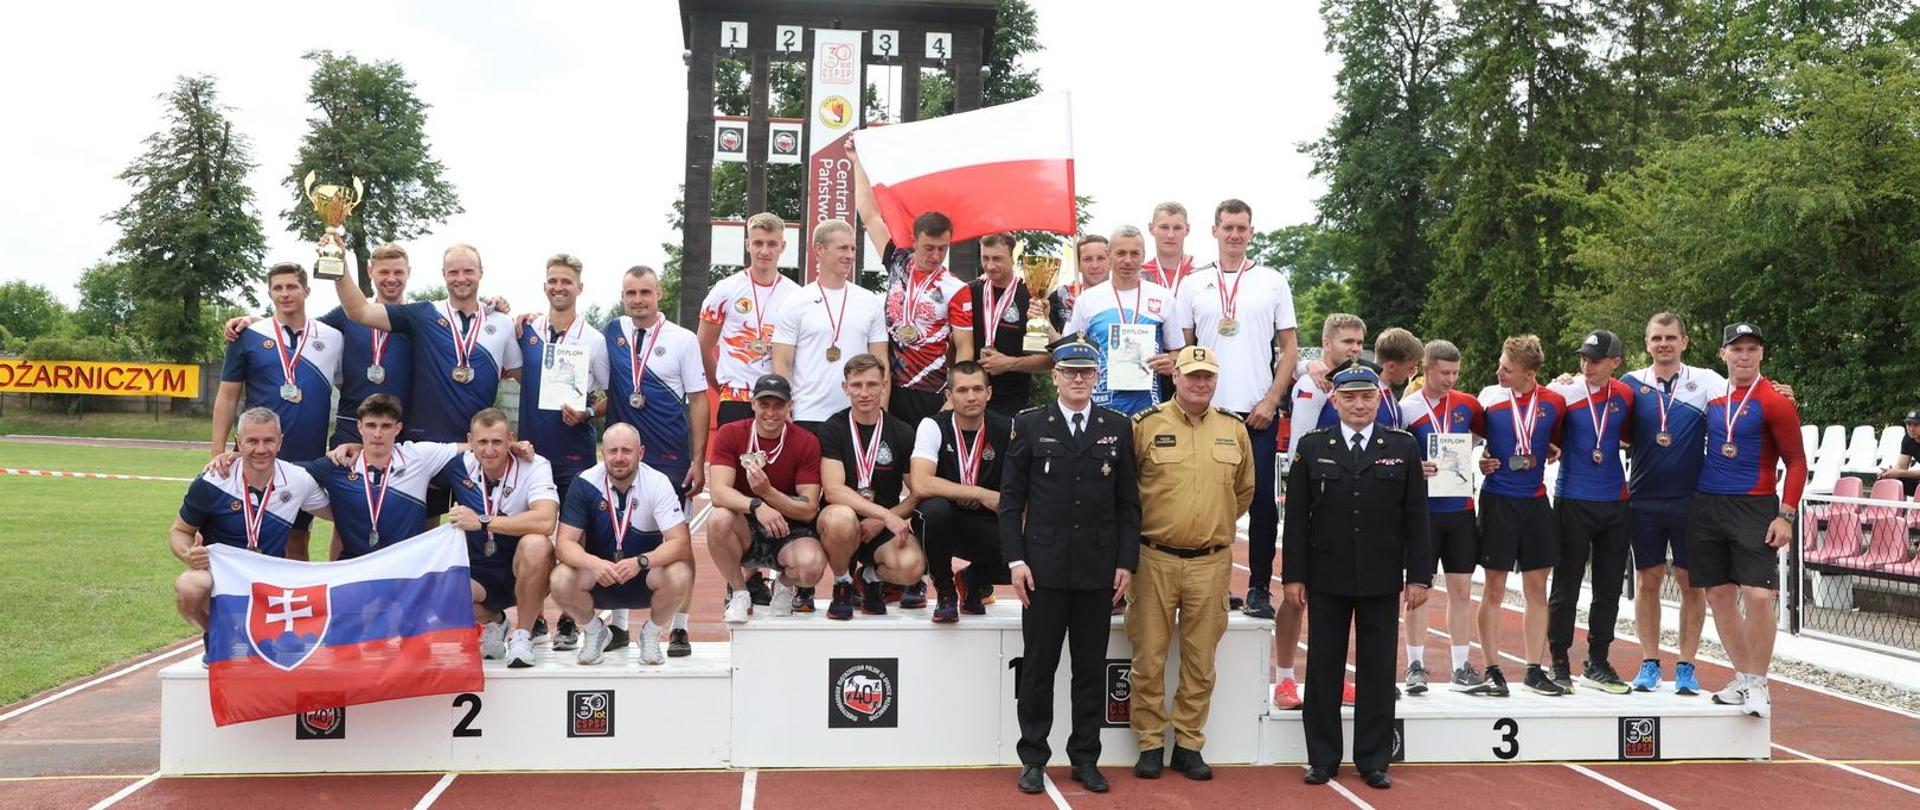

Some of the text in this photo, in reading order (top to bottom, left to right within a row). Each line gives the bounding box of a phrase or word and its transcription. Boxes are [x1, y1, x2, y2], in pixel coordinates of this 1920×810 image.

[730, 27, 738, 43] 1
[783, 30, 795, 46] 2
[879, 34, 891, 51] 3
[932, 38, 945, 53] 4
[557, 349, 583, 357] DYPLOM
[853, 684, 872, 704] 40
[452, 693, 482, 737] 2
[1492, 718, 1519, 760] 3
